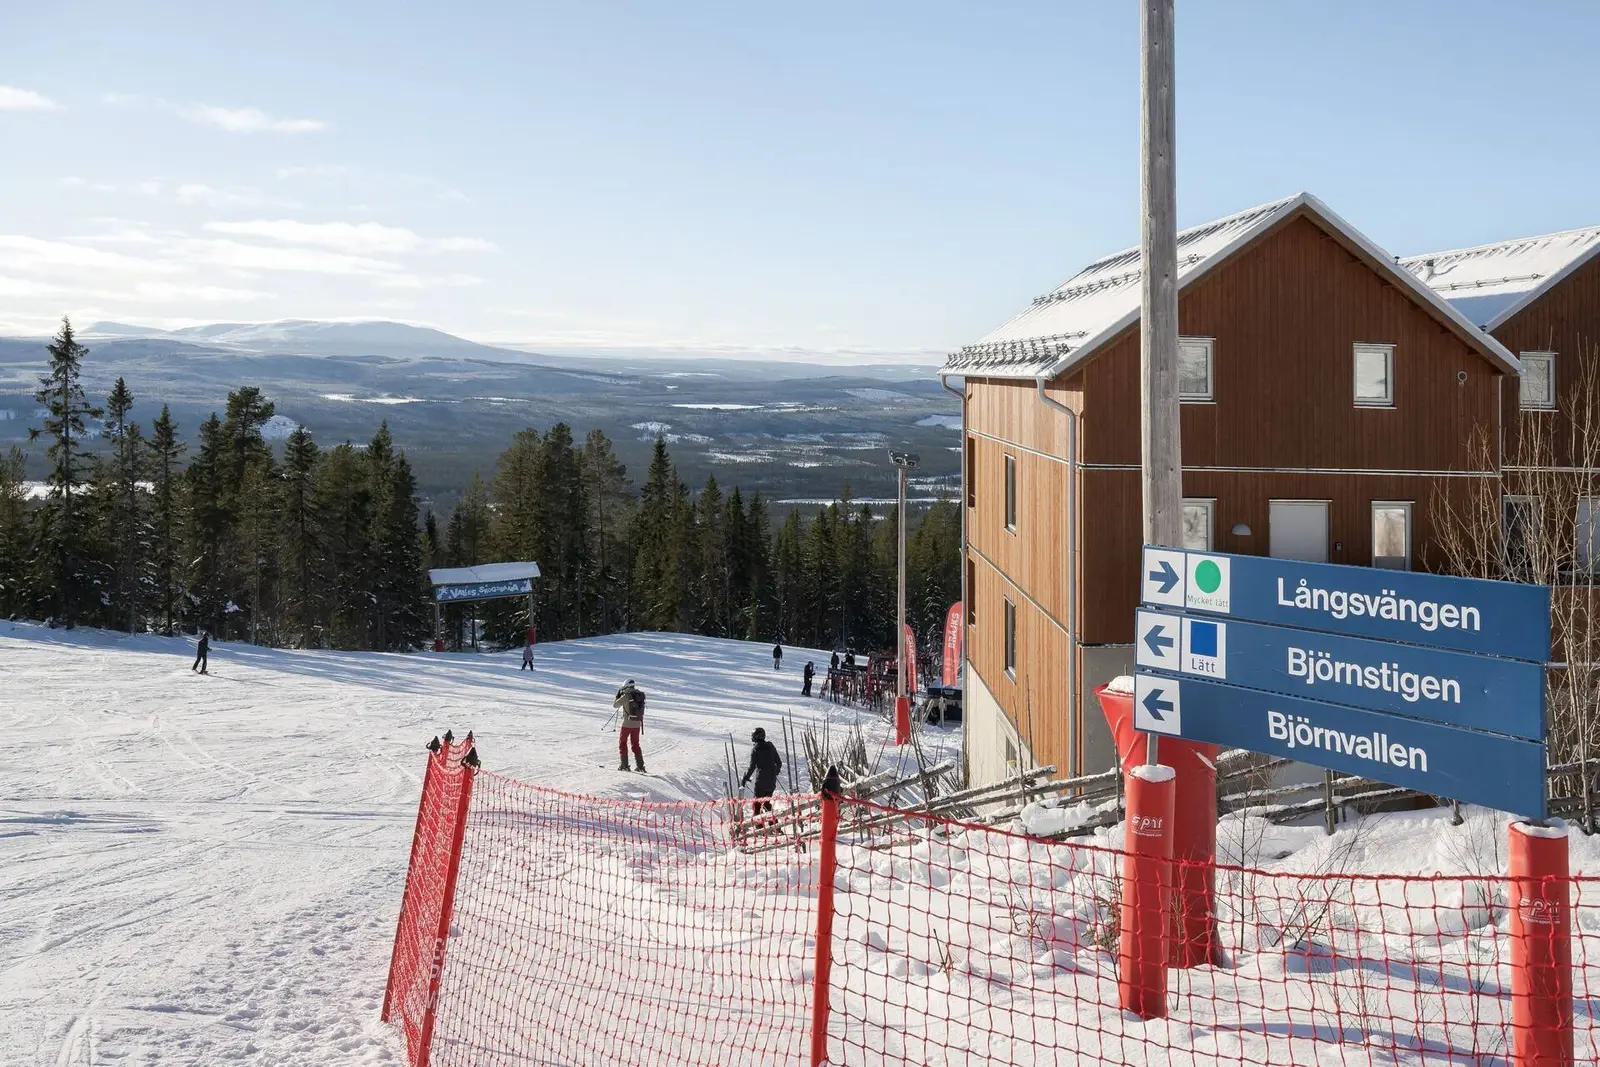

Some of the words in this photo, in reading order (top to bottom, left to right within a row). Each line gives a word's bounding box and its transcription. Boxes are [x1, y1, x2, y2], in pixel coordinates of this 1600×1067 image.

[1187, 595, 1212, 605] Mycket
[1215, 598, 1228, 607] lätt
[1277, 577, 1481, 632] Långsvängen
[1192, 657, 1215, 673] Lätt
[1287, 646, 1461, 704] Björnstigen
[1267, 710, 1428, 773] Björnvallen
